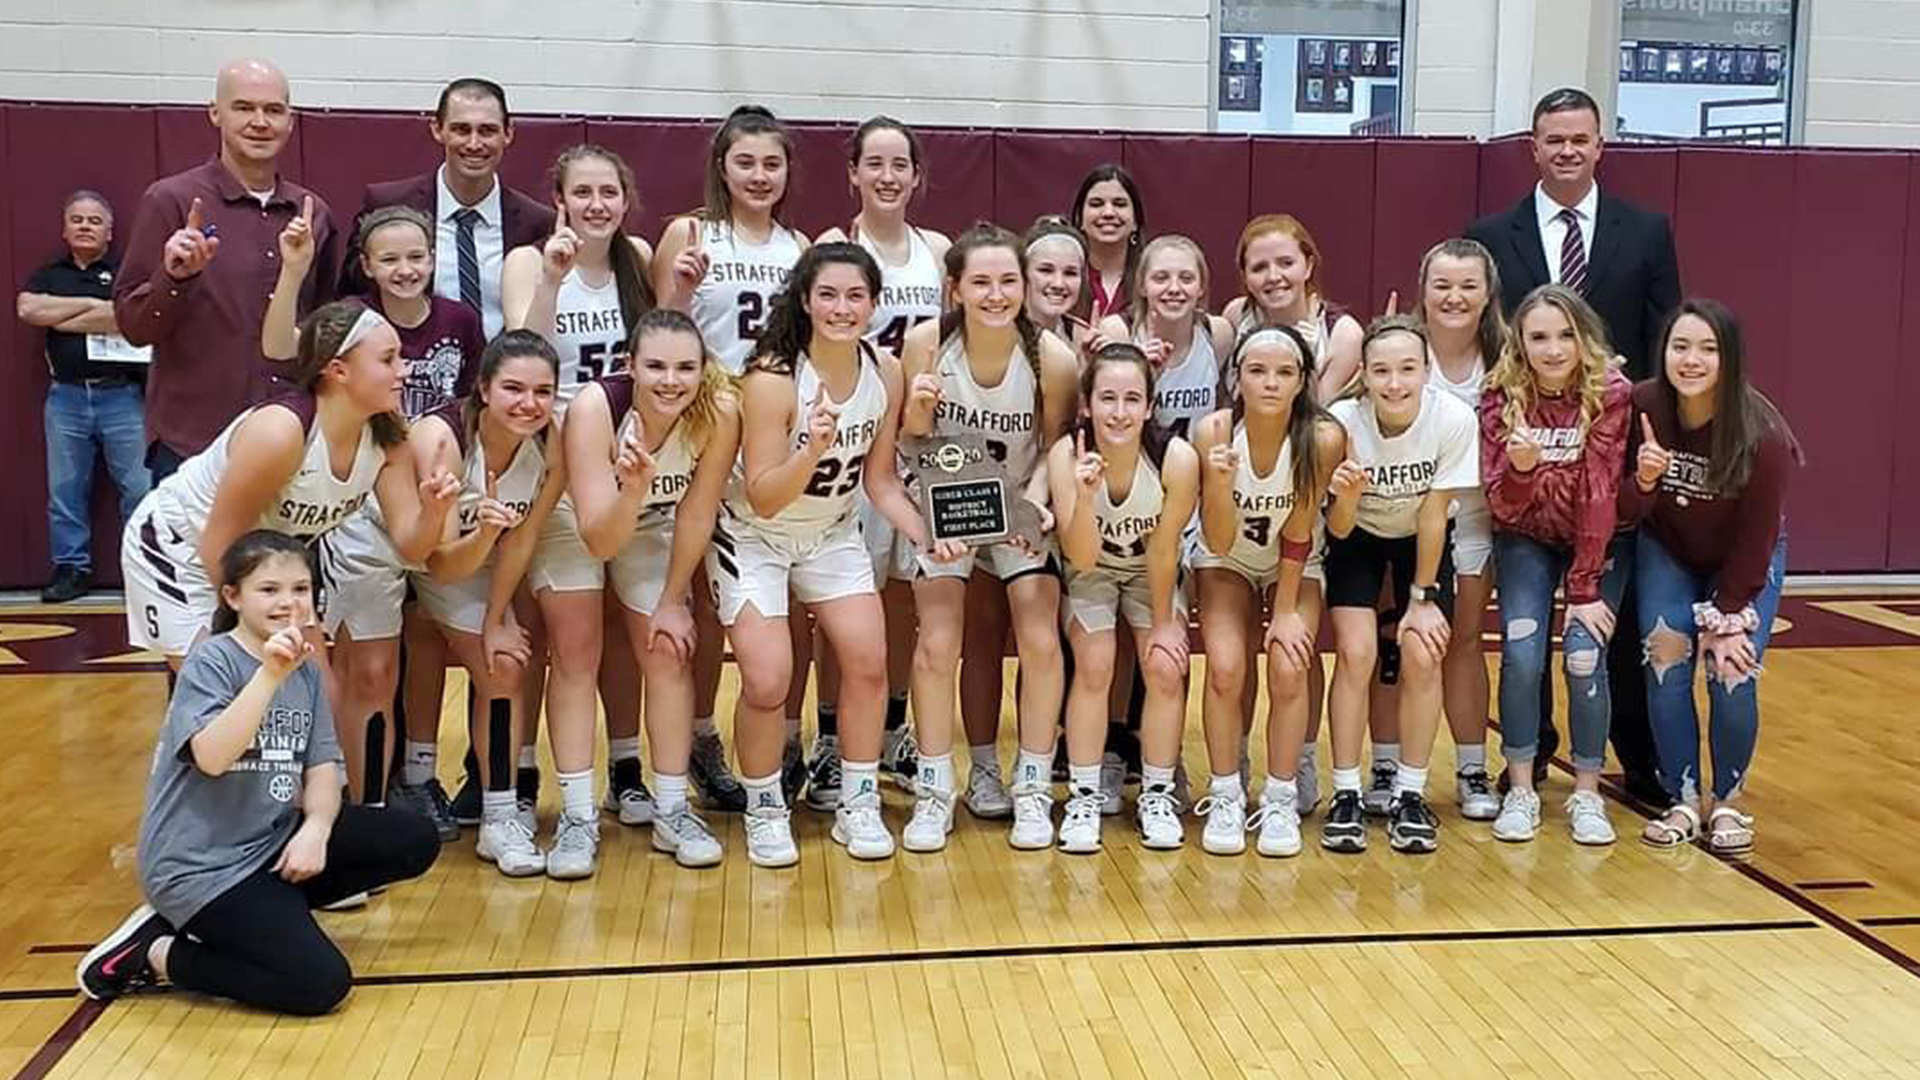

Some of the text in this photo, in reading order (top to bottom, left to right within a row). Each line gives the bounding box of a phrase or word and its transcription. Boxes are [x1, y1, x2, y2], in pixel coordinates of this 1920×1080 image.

[712, 262, 790, 285] STRAFFO
[555, 308, 620, 334] STRAFF
[1156, 387, 1211, 409] AFFORD
[933, 400, 1034, 433] STRAFFORD
[802, 454, 865, 497] 23
[1363, 459, 1438, 486] RAFFOR
[1232, 489, 1296, 512] RAFFOR
[968, 520, 996, 530] PLACE
[1243, 516, 1271, 546] 3
[145, 604, 160, 639] S
